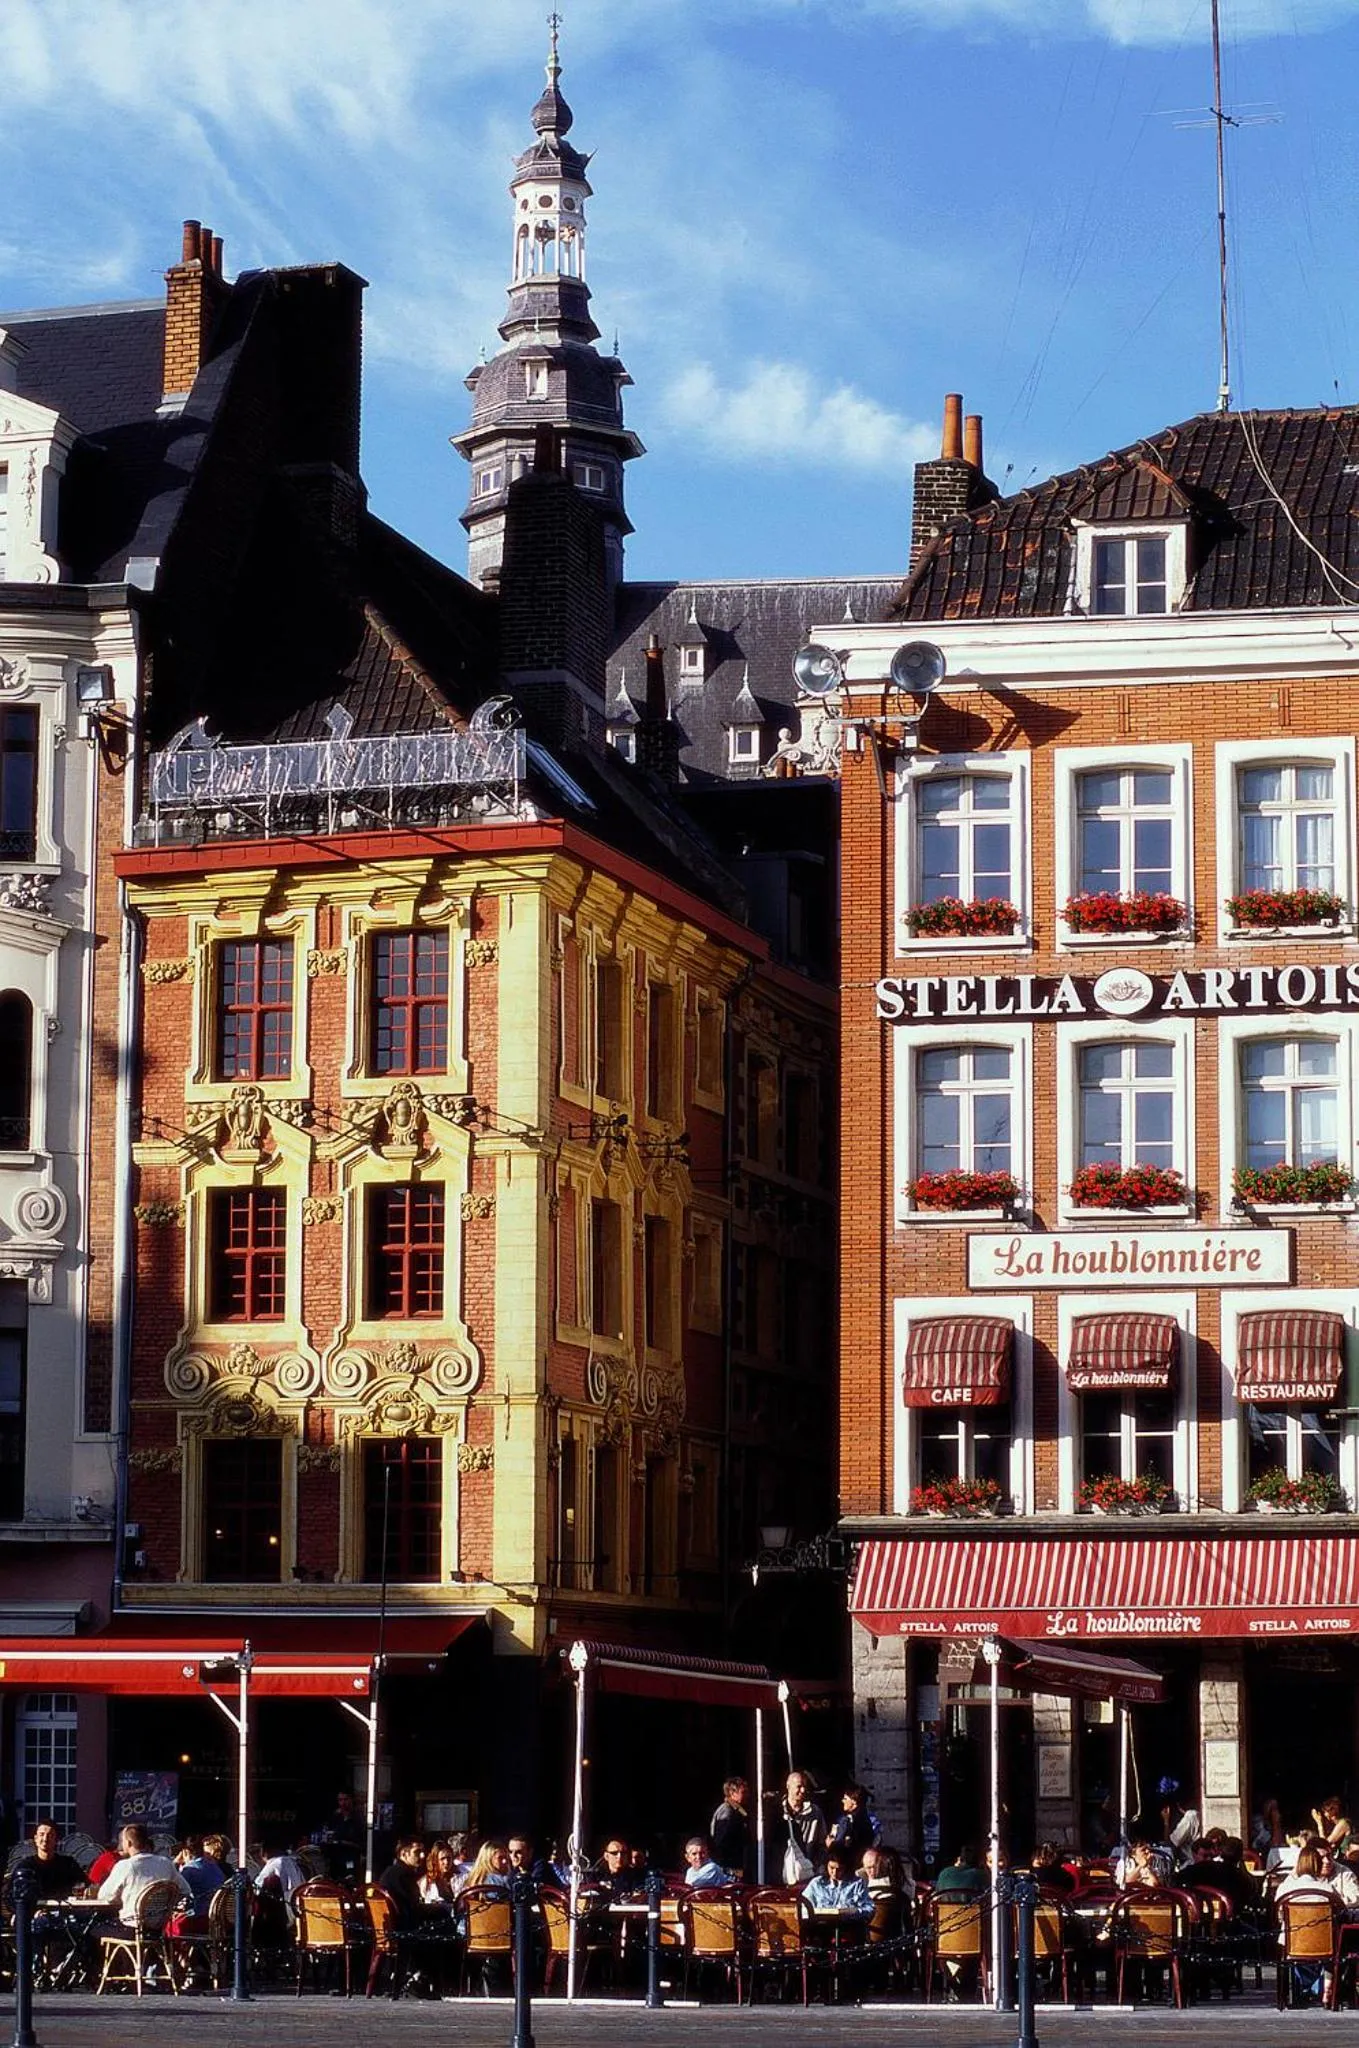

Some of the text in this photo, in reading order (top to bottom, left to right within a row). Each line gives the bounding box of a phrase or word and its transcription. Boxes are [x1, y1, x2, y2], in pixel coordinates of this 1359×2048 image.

[875, 973, 1086, 1018] STELLA
[994, 1237, 1044, 1277] La
[1071, 1372, 1089, 1388] La
[931, 1387, 972, 1403] CAFE
[1240, 1383, 1338, 1399] RESTAURANT
[899, 1622, 999, 1633] STELLA ARTOIS
[1046, 1611, 1078, 1636] La
[1249, 1618, 1350, 1632] STELLA ARTOIS
